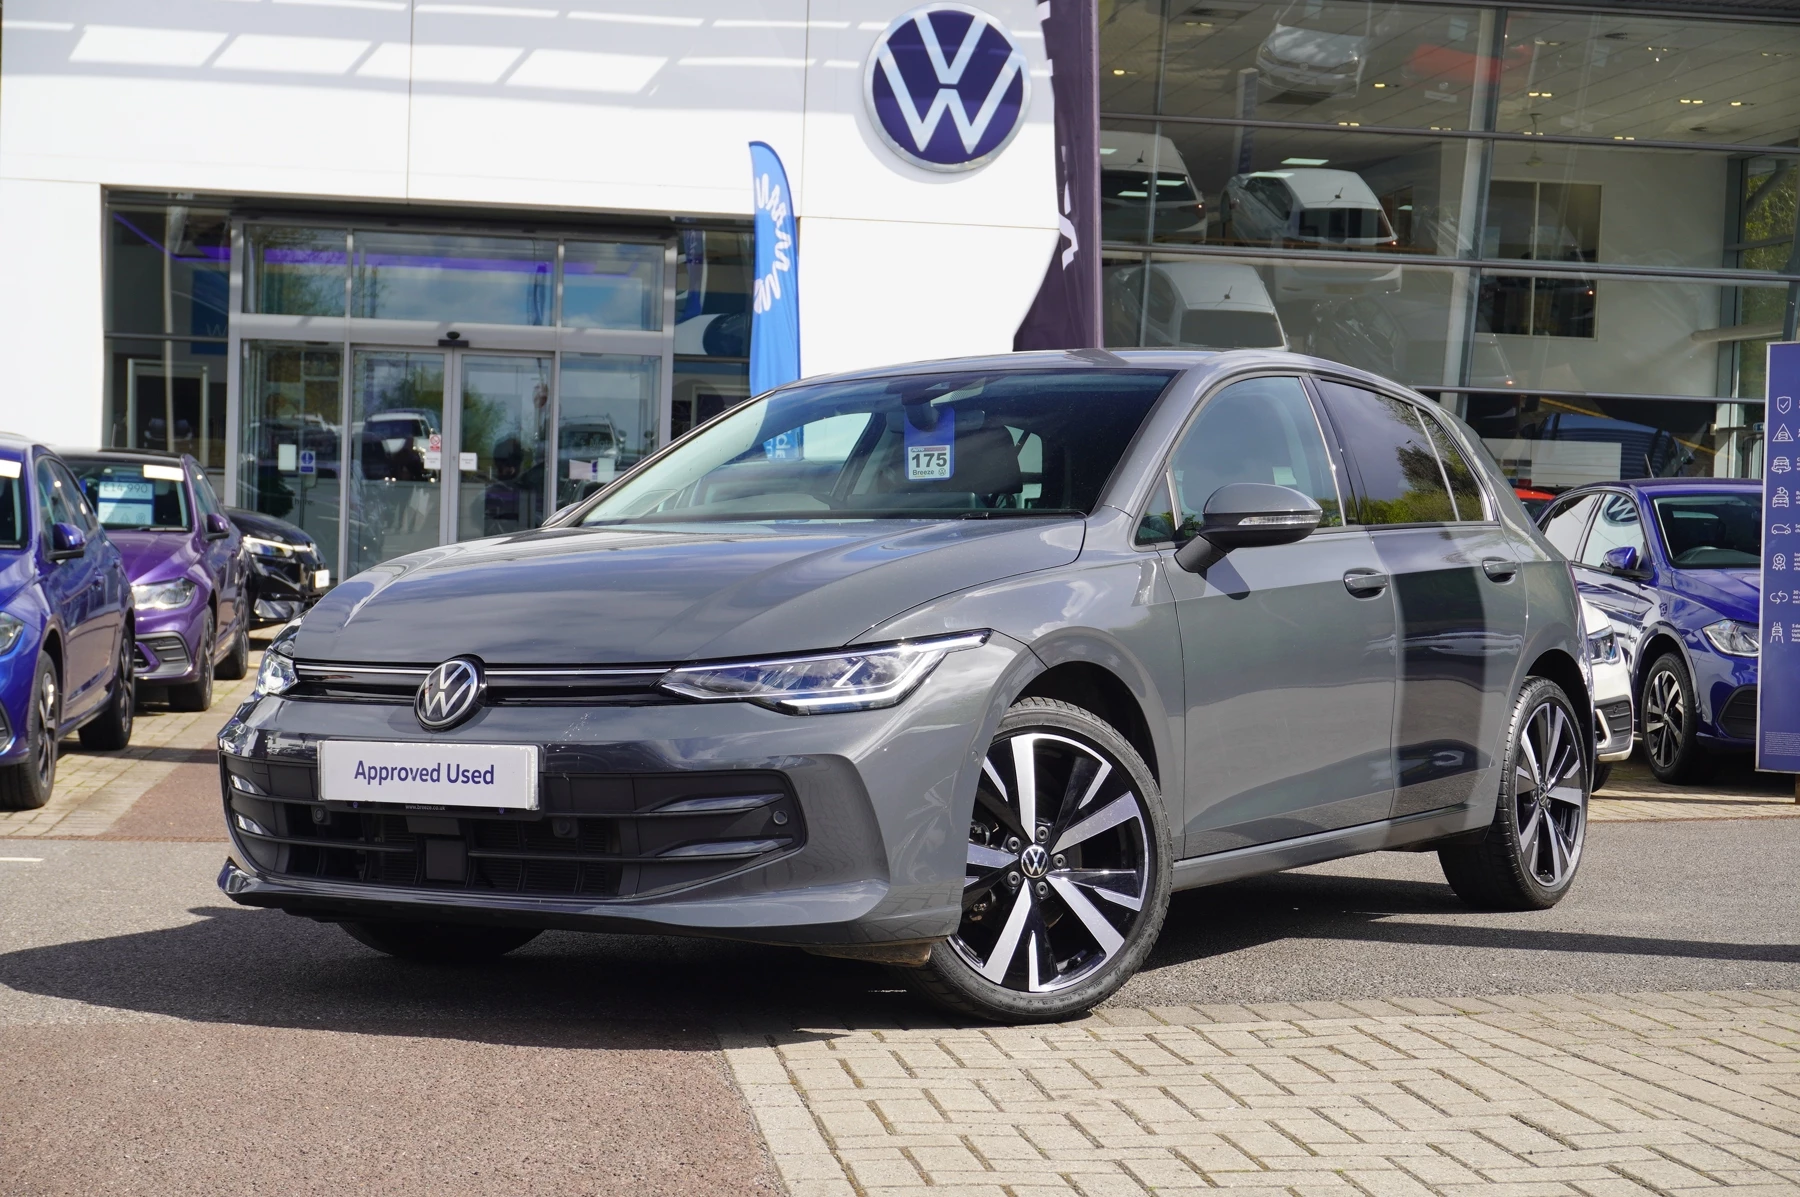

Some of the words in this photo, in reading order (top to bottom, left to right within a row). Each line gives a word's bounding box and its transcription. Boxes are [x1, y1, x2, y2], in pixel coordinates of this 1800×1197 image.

[911, 453, 948, 468] 175
[354, 760, 441, 786] Approved
[446, 763, 495, 785] Used
